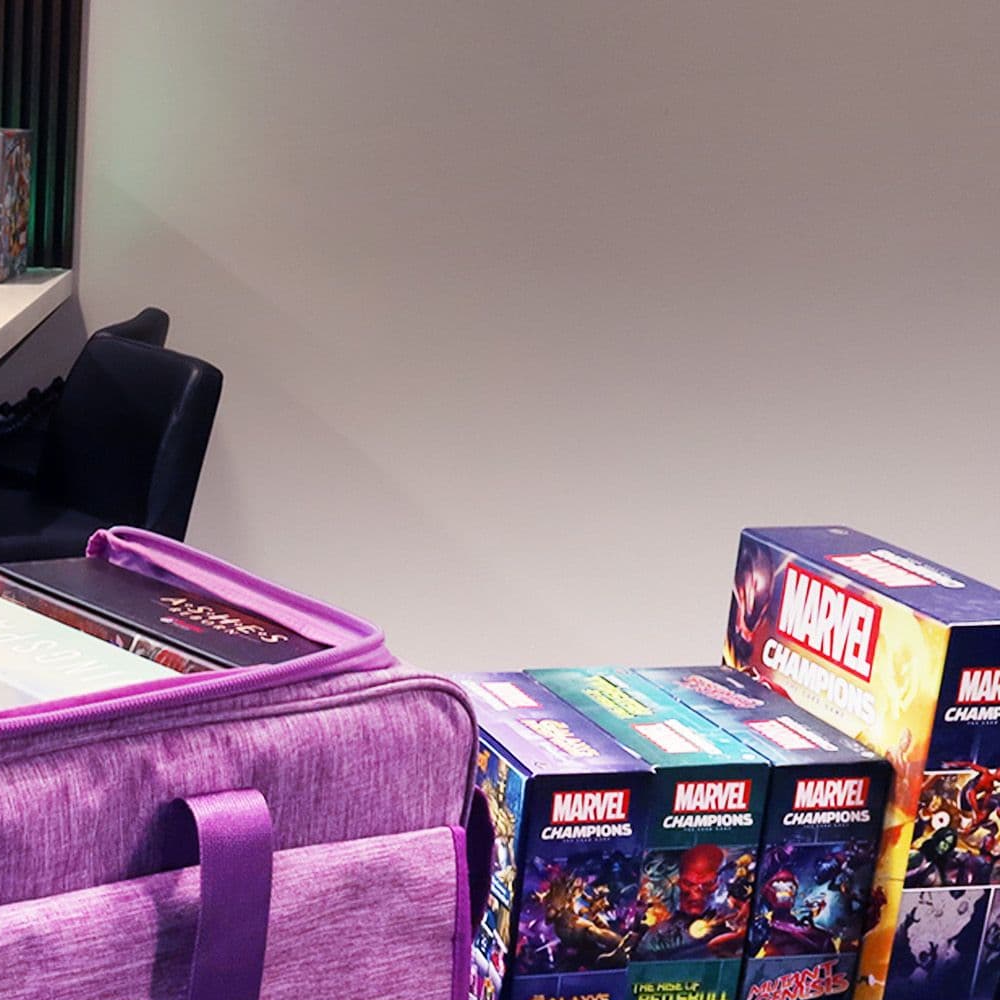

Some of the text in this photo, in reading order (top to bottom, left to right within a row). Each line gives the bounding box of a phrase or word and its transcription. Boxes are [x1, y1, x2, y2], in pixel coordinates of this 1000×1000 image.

[779, 567, 872, 679] MARVEL
[761, 638, 876, 727] CHAMPIONS
[552, 791, 626, 822] MARVEL
[674, 781, 747, 811] MARVEL
[794, 778, 865, 809] MARVEL
[540, 822, 632, 840] CHAMPIONS
[662, 813, 754, 829] CHAMPIONS
[783, 810, 871, 826] CHAMPIONS
